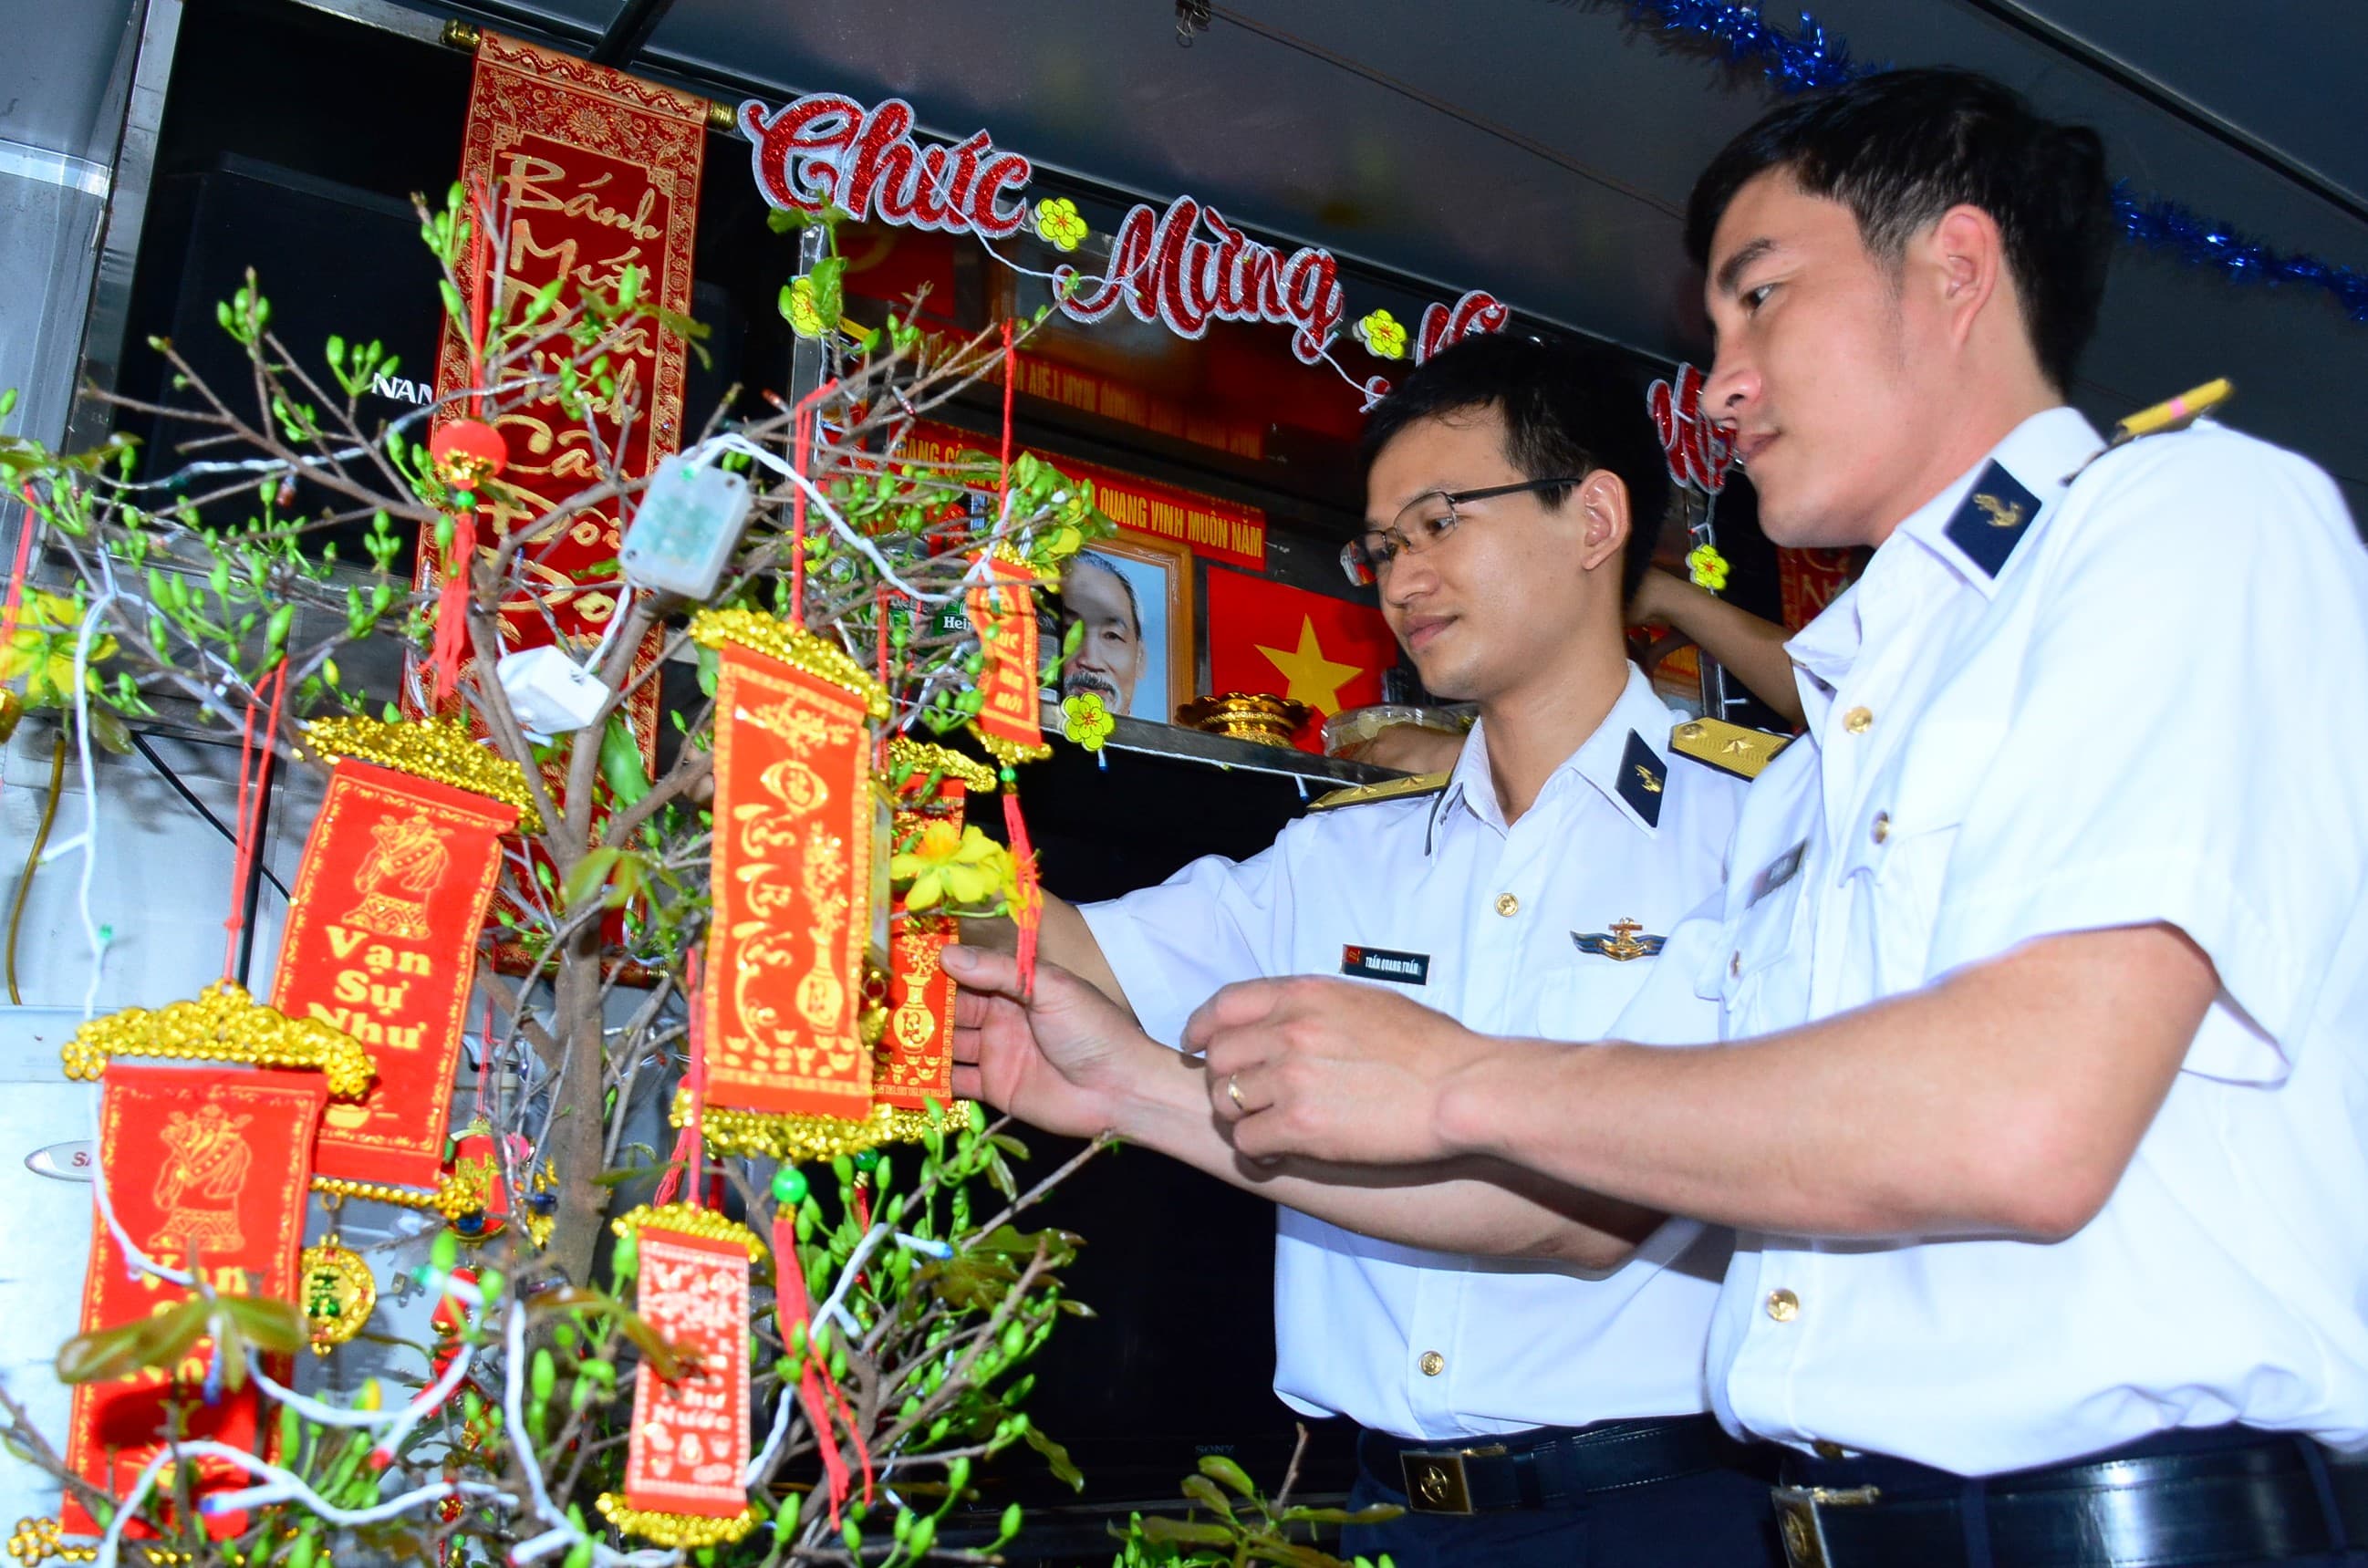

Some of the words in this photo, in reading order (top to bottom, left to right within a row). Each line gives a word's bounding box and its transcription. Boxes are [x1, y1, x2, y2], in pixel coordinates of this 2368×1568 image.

[499, 152, 664, 240] Bánh
[737, 92, 1032, 239] Chúc
[1053, 194, 1344, 365] Mừng
[1100, 486, 1148, 529] QUANG
[1151, 500, 1184, 538] VINH
[1188, 510, 1228, 549] MUÔN
[1231, 518, 1262, 558] NĂM
[325, 924, 431, 977] Vạn
[333, 969, 410, 1016] Sự
